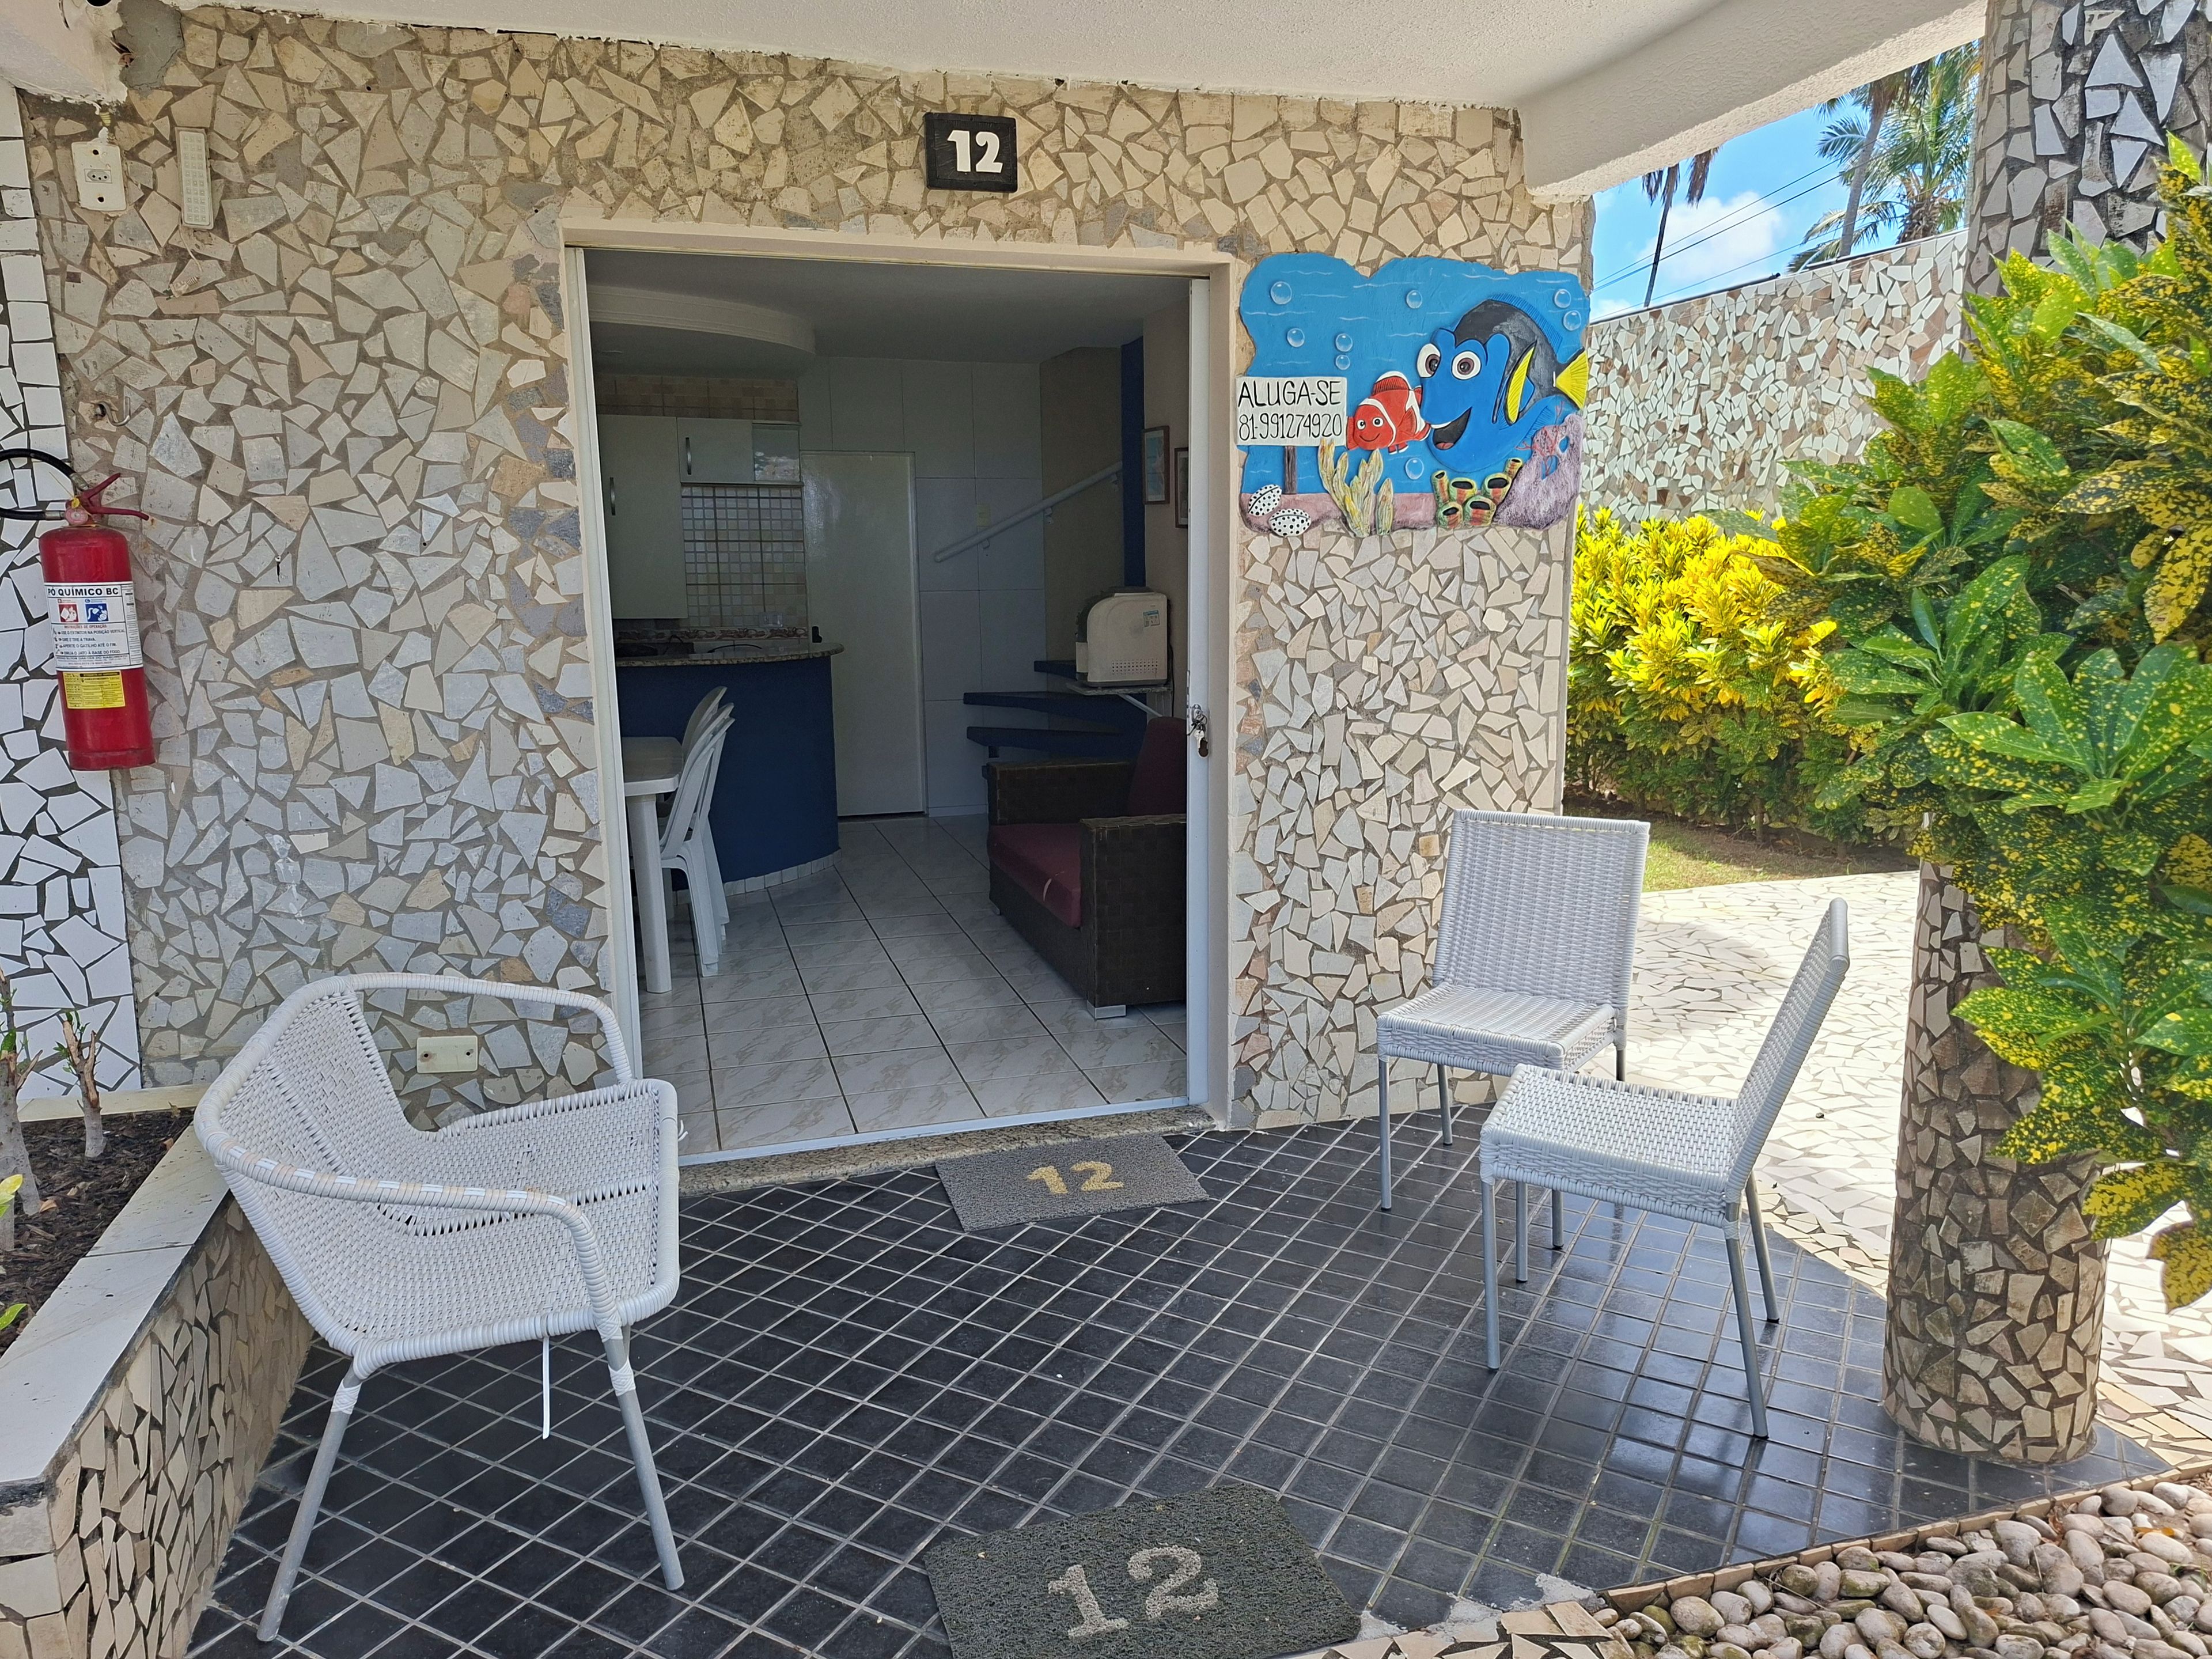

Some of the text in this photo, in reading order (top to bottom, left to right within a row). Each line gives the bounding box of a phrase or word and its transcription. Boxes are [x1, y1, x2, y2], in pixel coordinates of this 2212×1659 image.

[947, 130, 1003, 173] 12
[1237, 380, 1341, 408] ALUGA-SE
[1239, 412, 1342, 441] 81-991274920
[48, 587, 56, 596] PÓ
[58, 587, 103, 596] QUÍMICO
[1026, 1160, 1124, 1194] 12
[1048, 1544, 1219, 1639] 12
